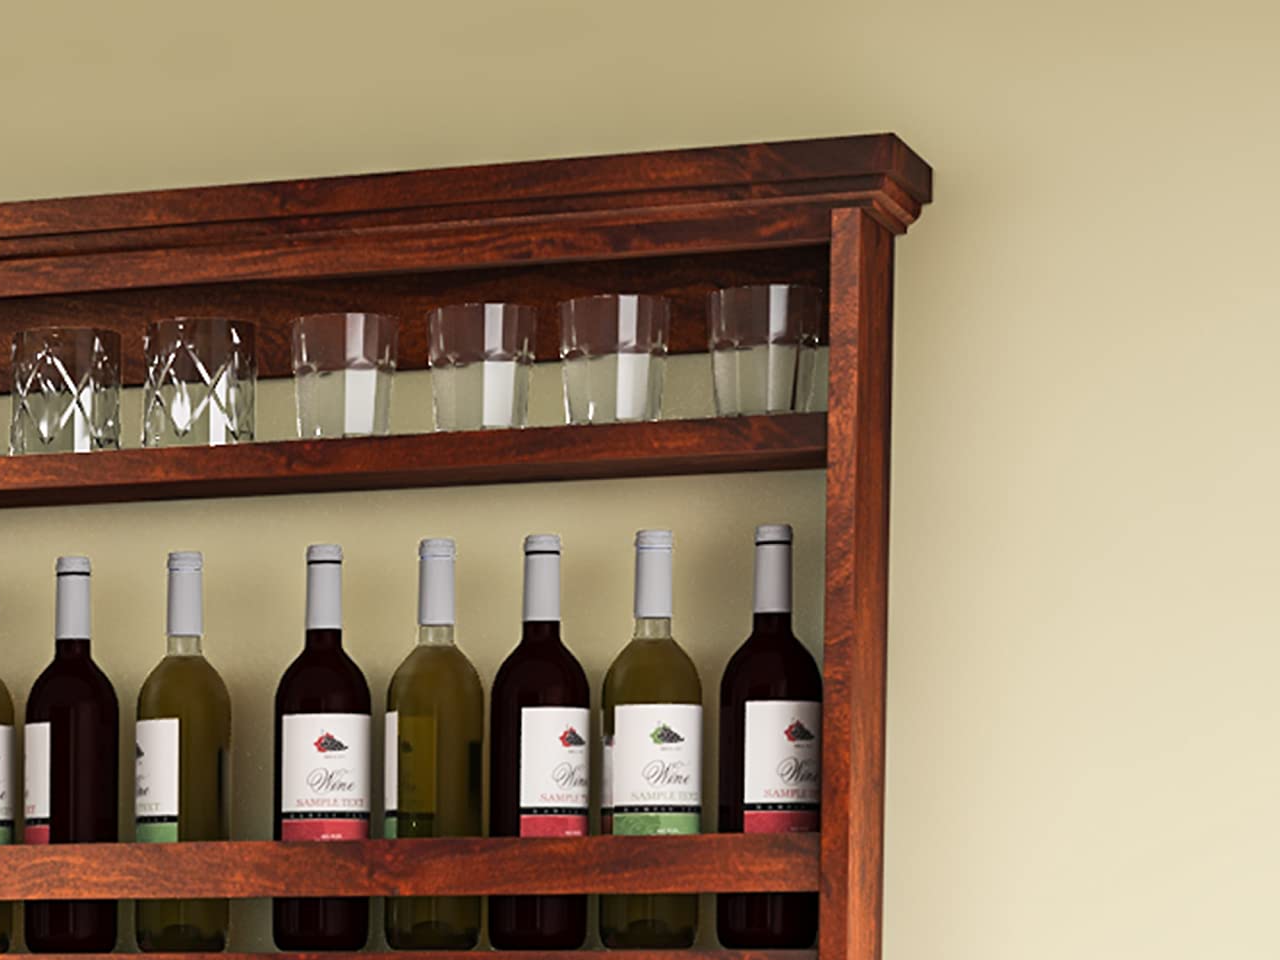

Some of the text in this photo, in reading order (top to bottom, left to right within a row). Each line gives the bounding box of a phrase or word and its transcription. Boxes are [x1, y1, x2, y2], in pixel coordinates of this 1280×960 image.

[306, 767, 356, 796] Wine
[642, 759, 691, 788] Wine
[295, 798, 338, 807] SAMPLE
[631, 791, 676, 801] SAMPLE
